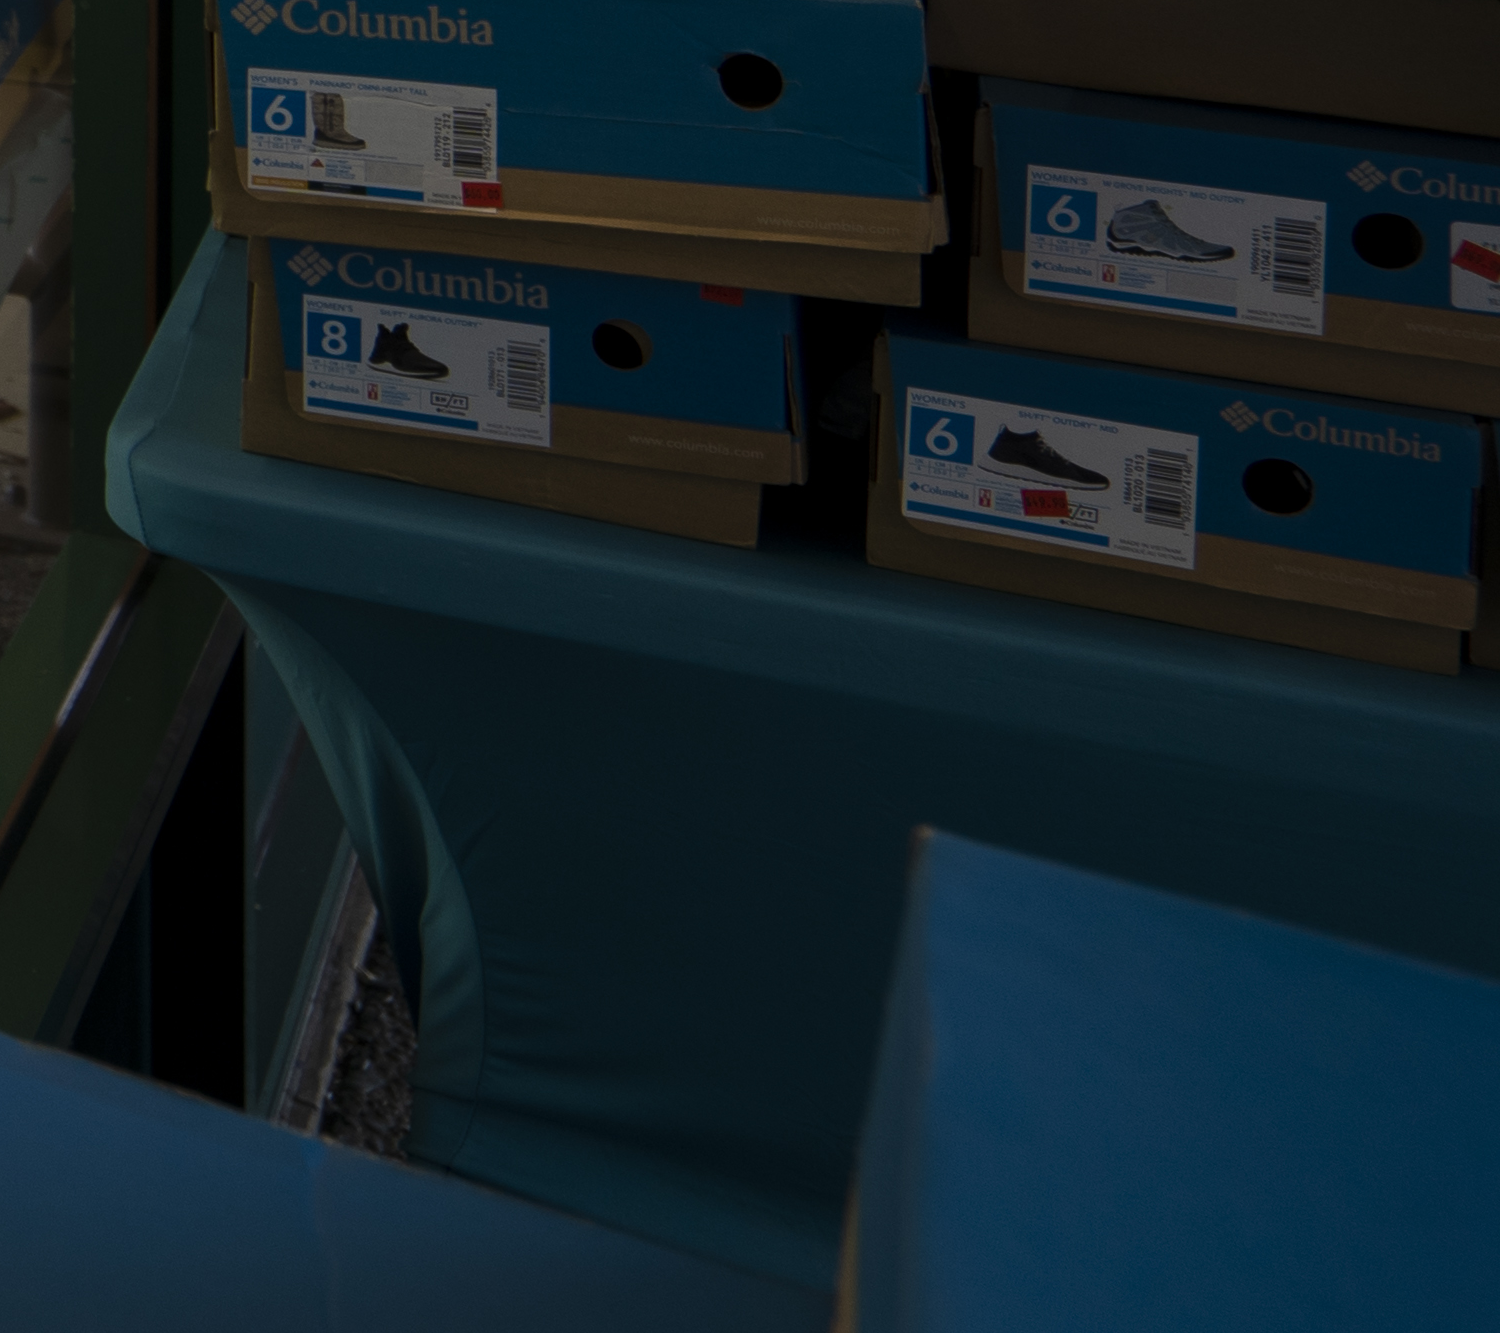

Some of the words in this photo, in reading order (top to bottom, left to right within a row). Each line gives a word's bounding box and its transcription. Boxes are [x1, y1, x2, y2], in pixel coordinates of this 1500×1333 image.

[251, 75, 299, 86] WOMEN'S
[264, 94, 294, 131] 6
[262, 158, 304, 169] Columbia
[1031, 171, 1088, 185] WOMEN'S
[1113, 181, 1144, 192] GROVE
[1189, 191, 1207, 200] MID
[1046, 194, 1081, 234] 6
[1261, 224, 1272, 242] 411
[1043, 262, 1093, 276] Columbia
[1260, 248, 1271, 283] YL1042
[337, 252, 550, 310] Columbia
[306, 300, 354, 313] WOMEN'S
[321, 319, 348, 356] 8
[318, 380, 360, 394] Columbia
[911, 392, 966, 410] WOMEN'S
[924, 416, 959, 457] 6
[1099, 424, 1119, 435] MID
[1262, 408, 1442, 463] Columbia
[628, 433, 765, 460] www.columbia.com
[1134, 454, 1145, 472] 013
[921, 484, 969, 500] Columbia
[1132, 478, 1144, 514] BL1020
